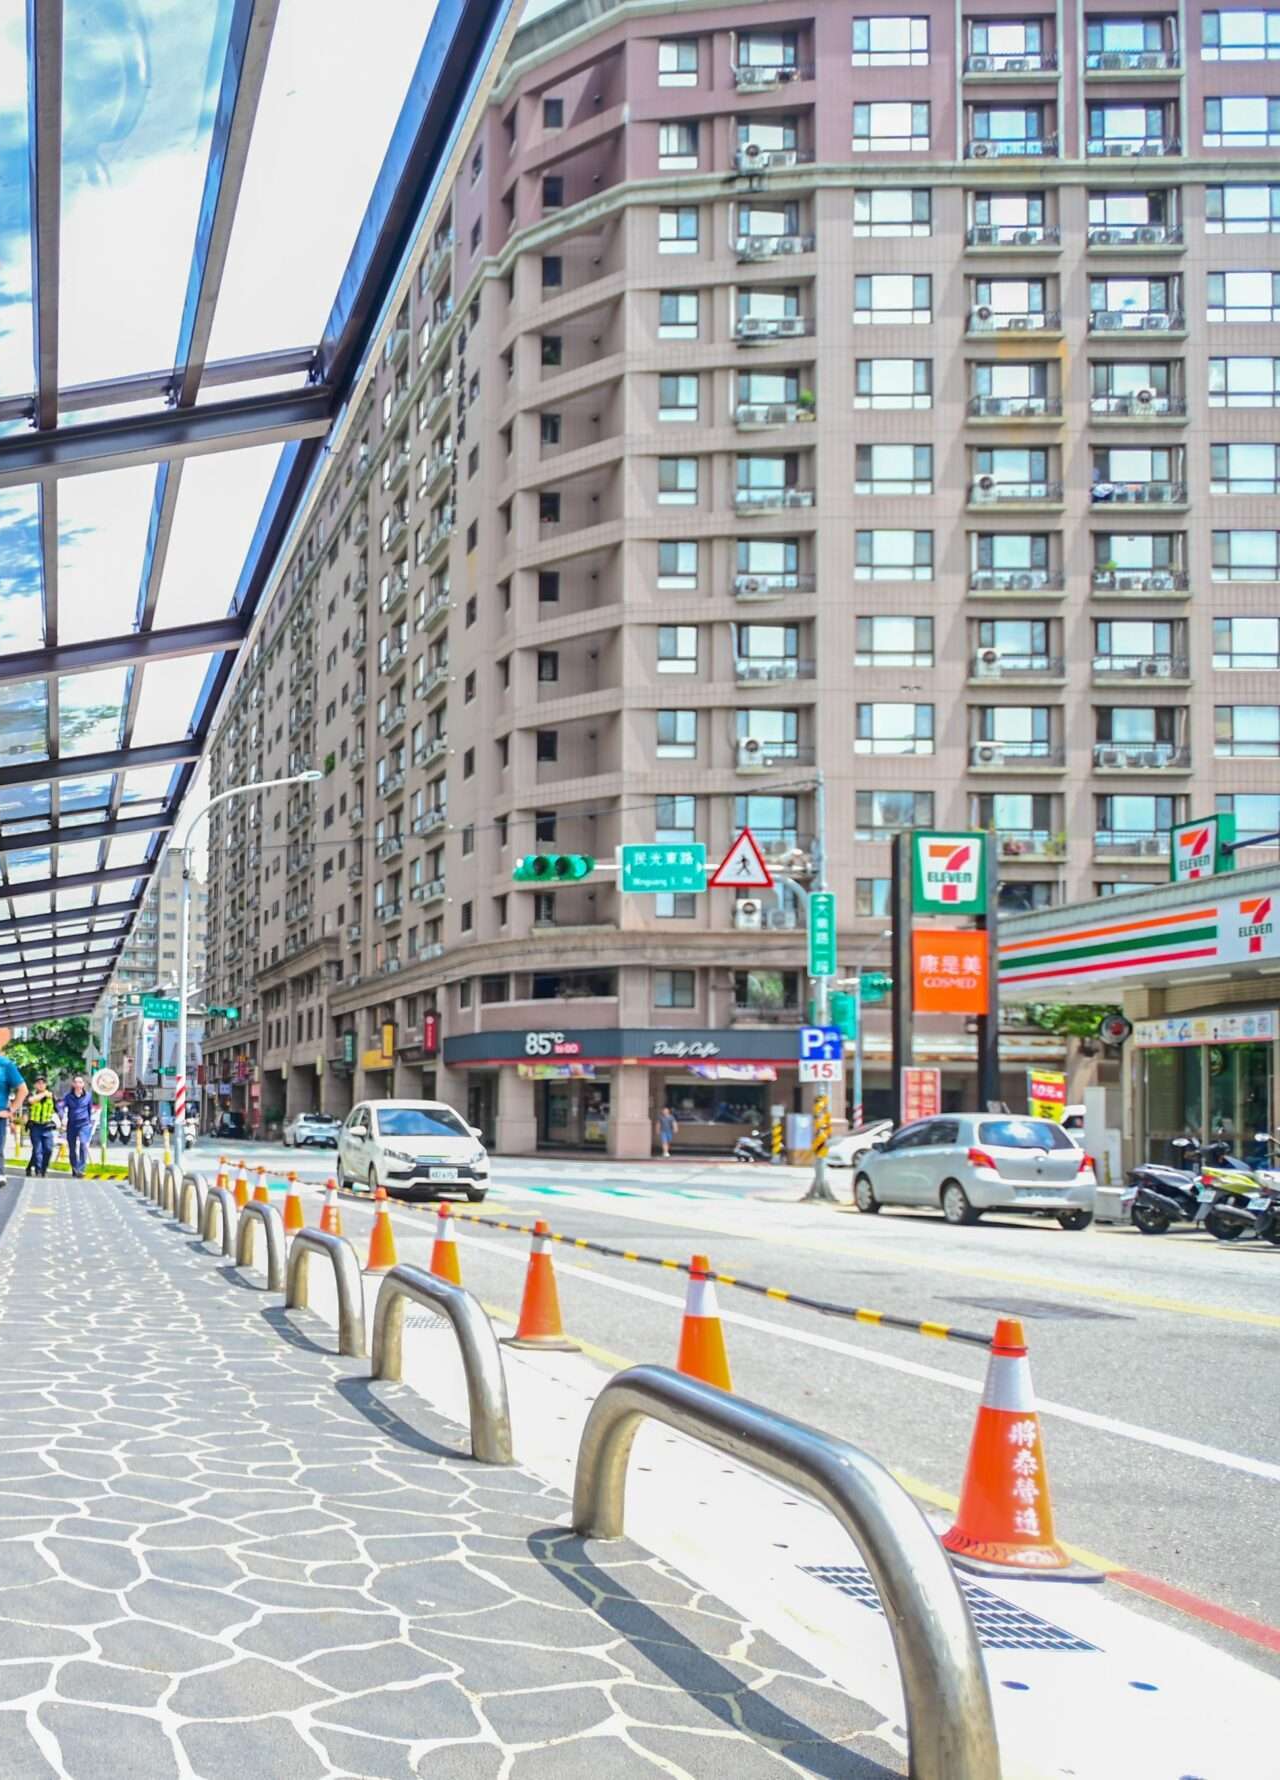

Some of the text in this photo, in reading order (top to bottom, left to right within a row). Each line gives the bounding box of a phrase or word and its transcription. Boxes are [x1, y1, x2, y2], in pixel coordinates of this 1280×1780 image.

[920, 955, 981, 975] 康是美
[923, 977, 976, 989] COSMED
[802, 1029, 824, 1057] P
[811, 1063, 833, 1078] 15
[1008, 1420, 1040, 1537] 將泰營造
